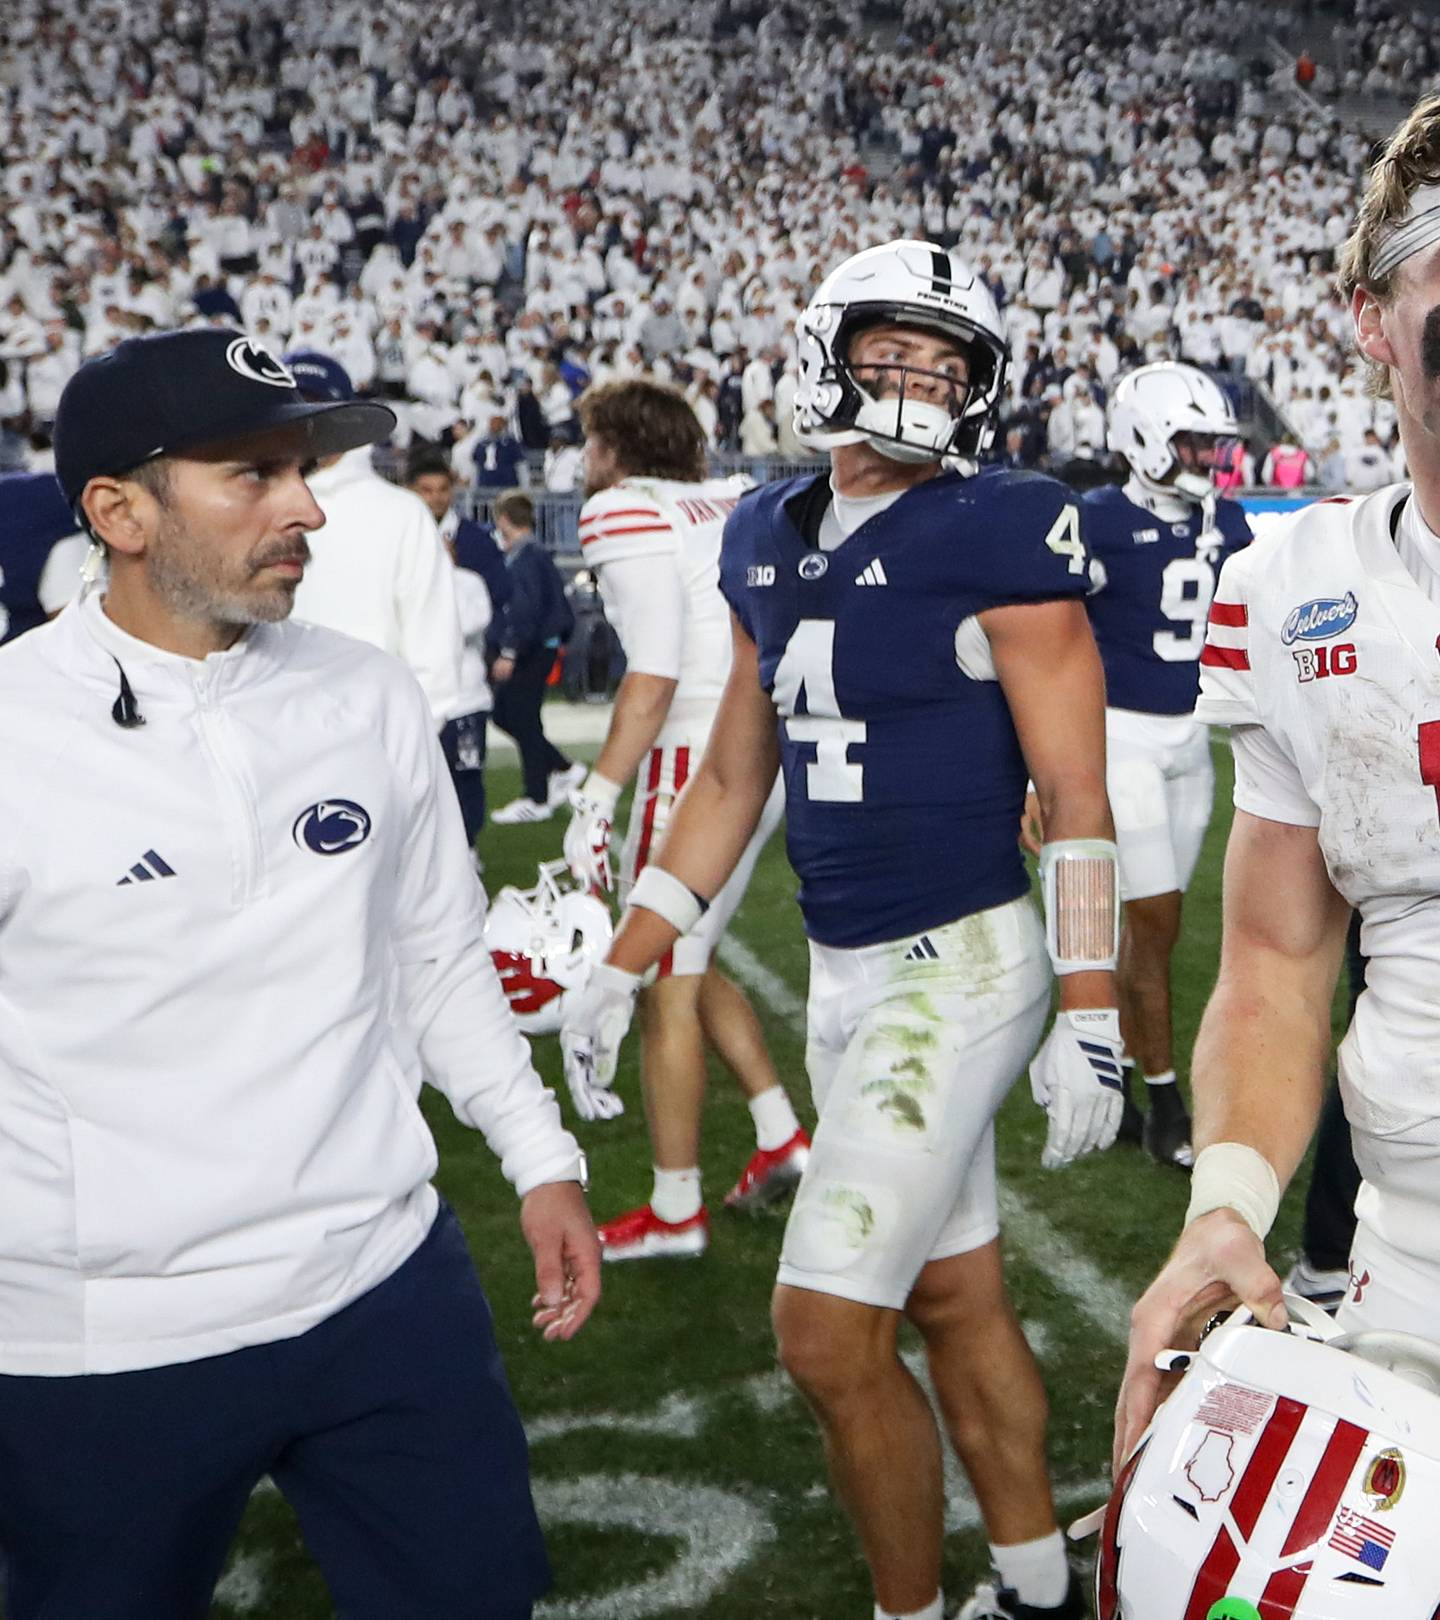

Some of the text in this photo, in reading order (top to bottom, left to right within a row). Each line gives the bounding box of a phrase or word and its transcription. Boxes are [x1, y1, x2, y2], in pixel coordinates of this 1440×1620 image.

[917, 291, 969, 312] PENN STATE
[1045, 503, 1087, 575] 4
[1152, 558, 1215, 662] 9
[1281, 591, 1359, 646] Culver's
[771, 619, 867, 802] 4
